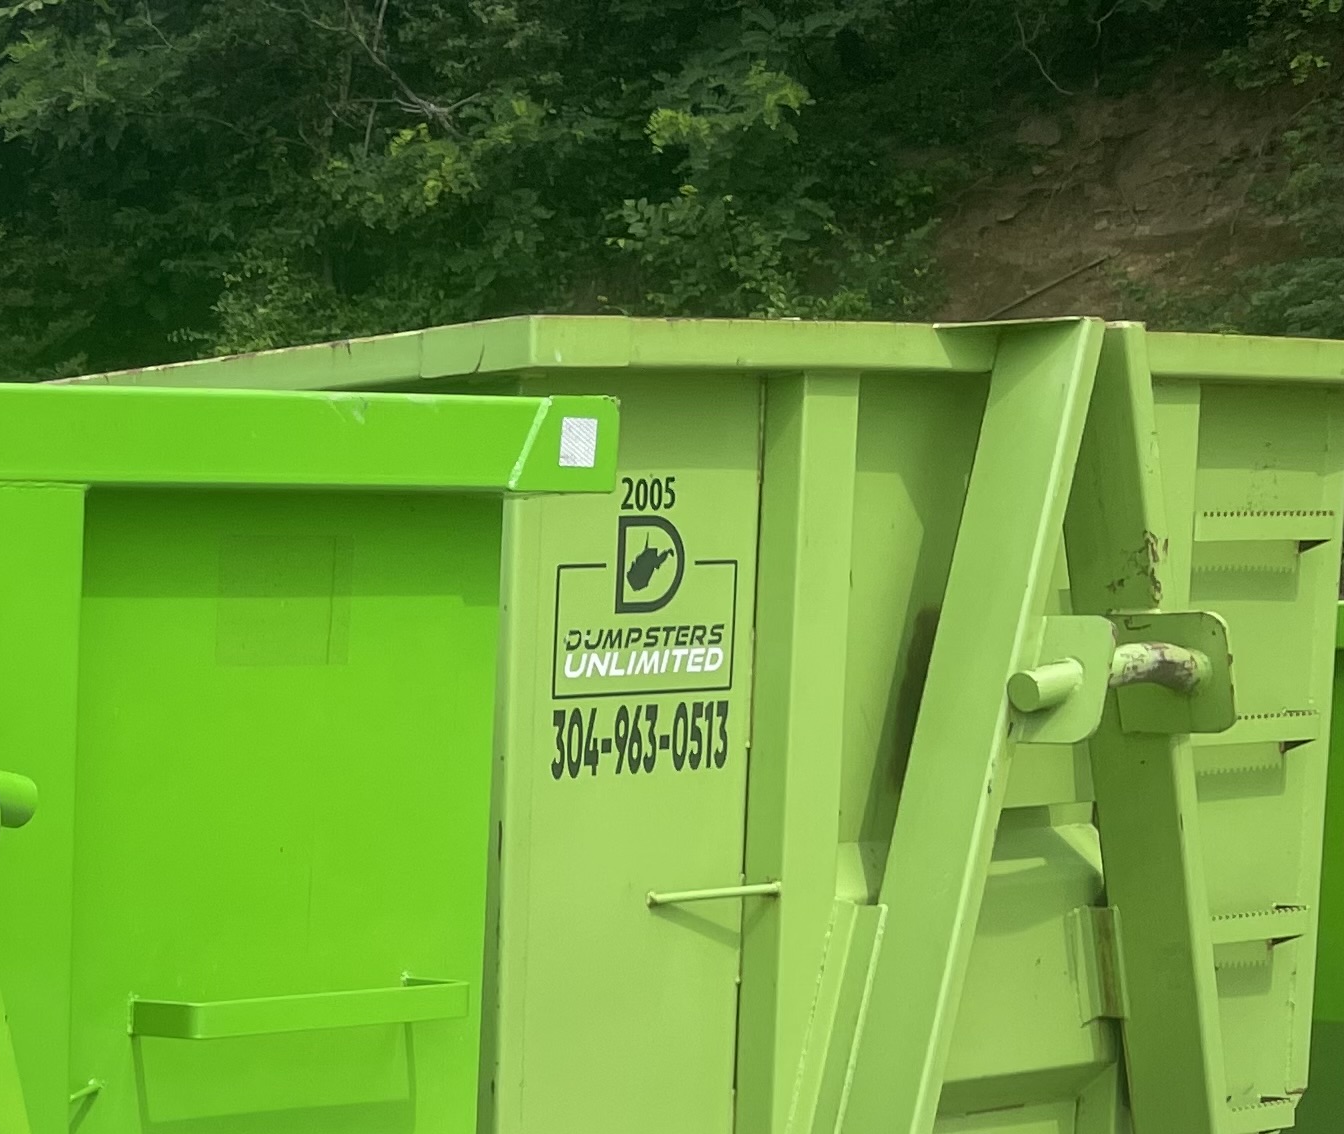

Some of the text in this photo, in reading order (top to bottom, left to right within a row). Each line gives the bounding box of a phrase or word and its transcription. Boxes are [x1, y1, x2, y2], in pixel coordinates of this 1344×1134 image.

[620, 476, 676, 511] 2005
[615, 515, 685, 614] D
[564, 624, 725, 652] DUMPSTERS
[564, 647, 724, 679] UNLIMITED
[551, 700, 729, 780] 304-963-0513
